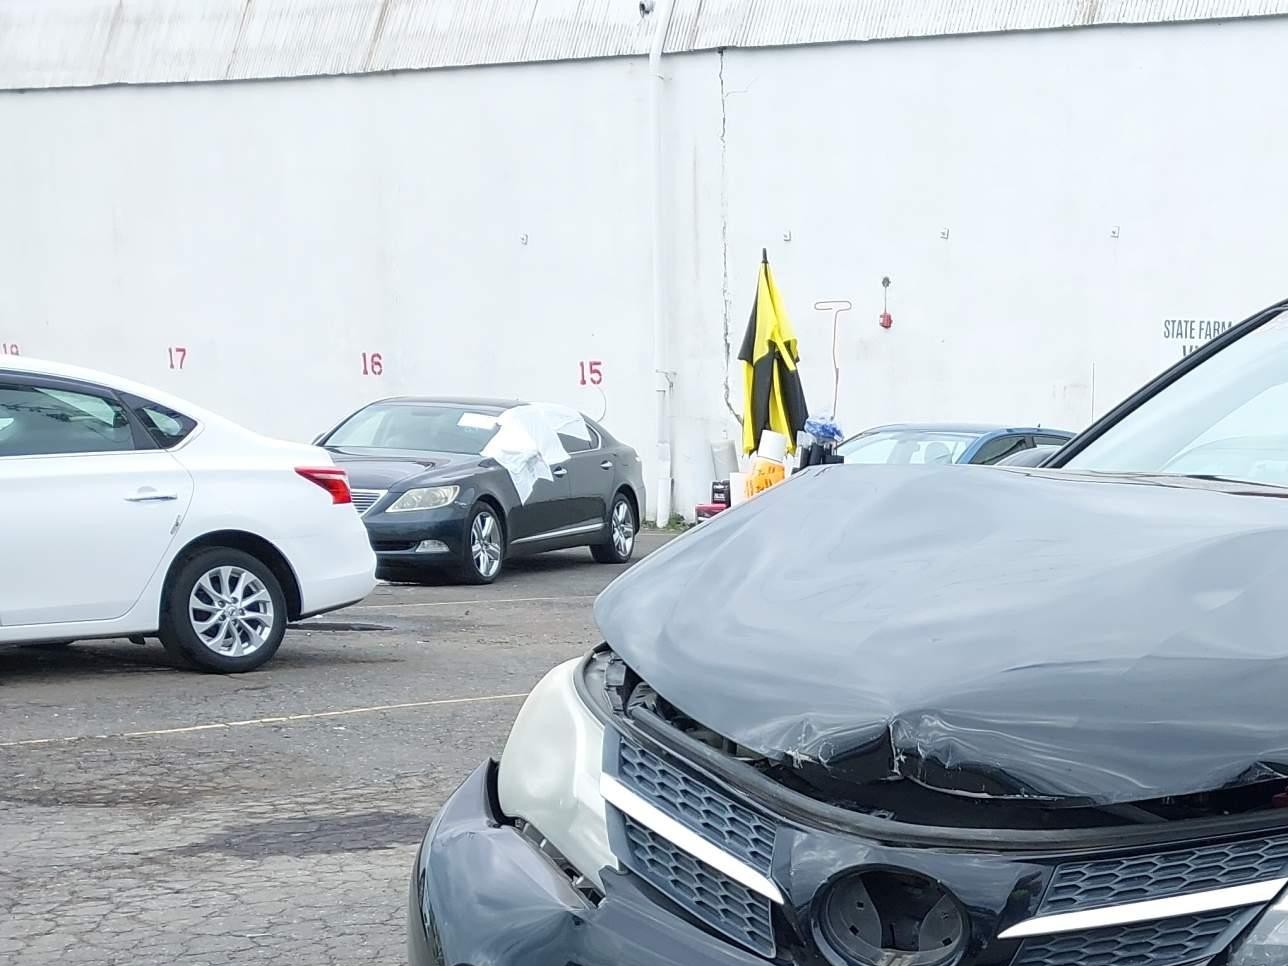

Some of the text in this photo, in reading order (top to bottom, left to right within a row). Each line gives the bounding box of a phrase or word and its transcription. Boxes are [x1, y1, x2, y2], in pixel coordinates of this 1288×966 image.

[1163, 319, 1197, 339] STATE
[168, 347, 186, 369] 17
[362, 352, 383, 376] 16
[579, 360, 603, 385] 15
